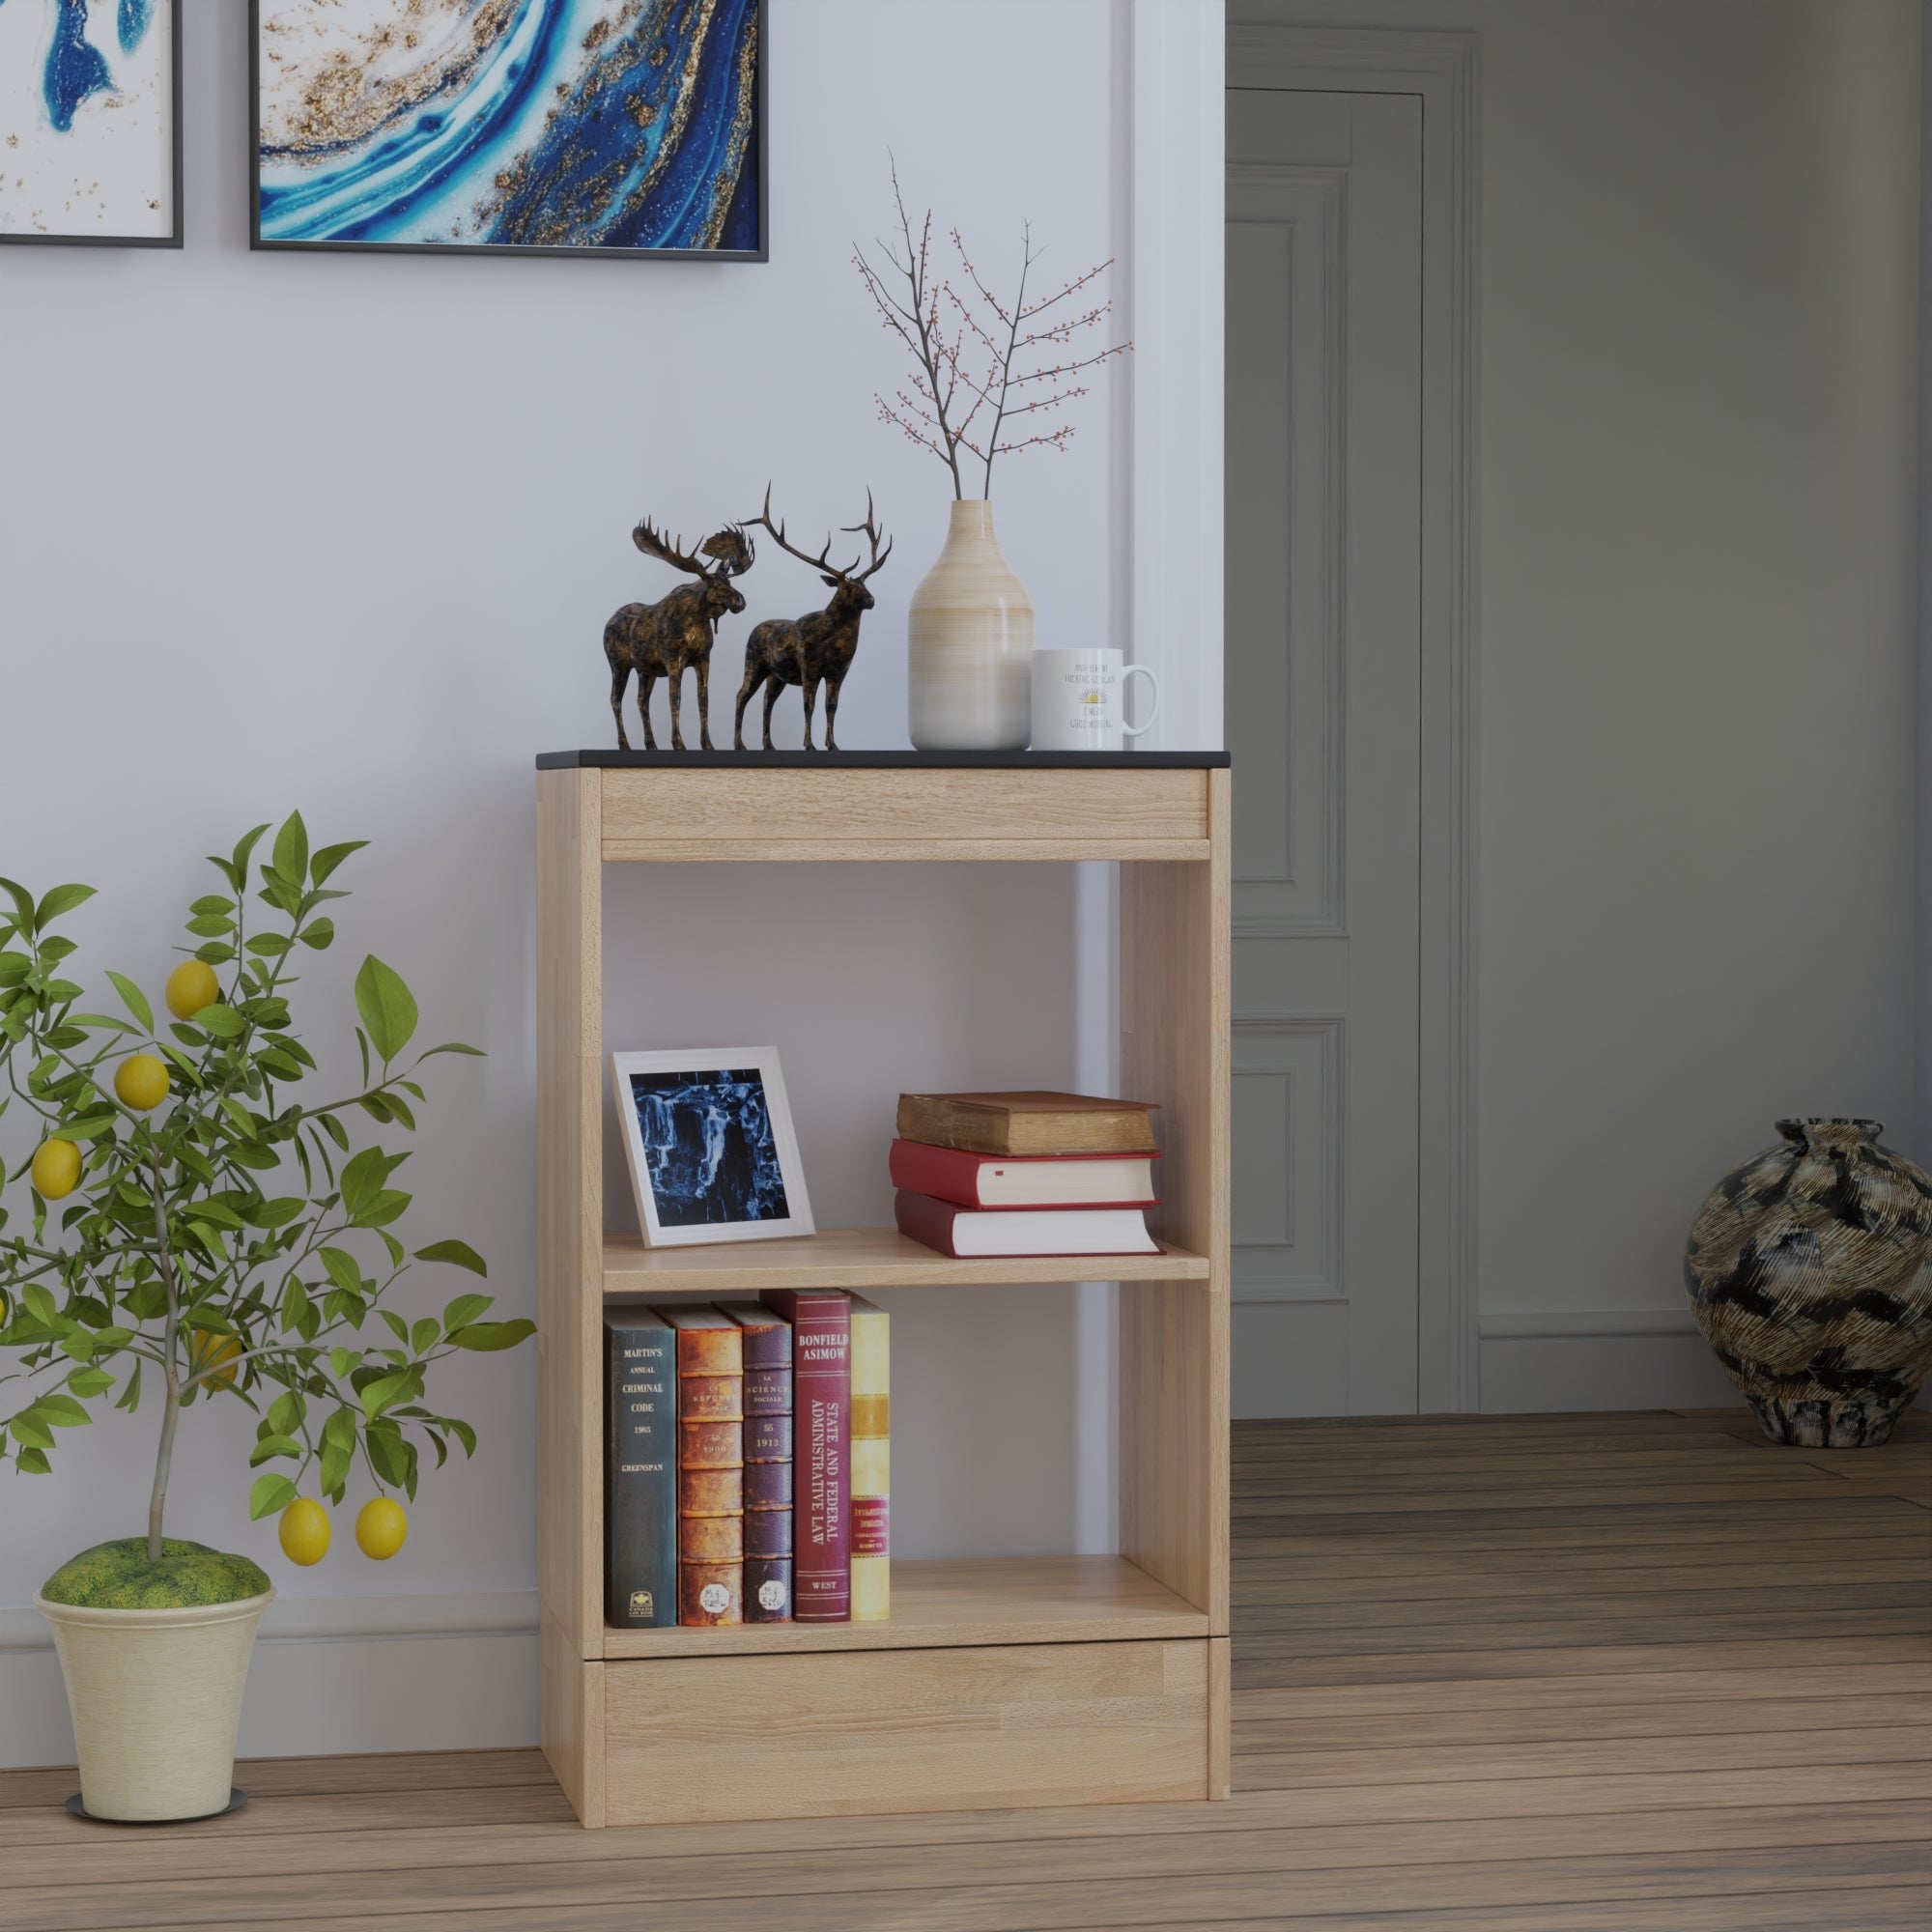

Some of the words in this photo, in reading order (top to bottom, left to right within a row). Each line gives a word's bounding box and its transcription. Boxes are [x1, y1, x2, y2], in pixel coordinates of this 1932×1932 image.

[799, 1334, 849, 1346] BONFIELD
[624, 1348, 663, 1358] MARTIN'S
[804, 1348, 845, 1360] ASIMOW
[622, 1383, 664, 1393] CRIMINAL
[631, 1404, 654, 1412] CODE
[827, 1403, 838, 1443] STATE
[811, 1399, 824, 1511] ADMINISTRATIVE
[621, 1463, 663, 1472] GREENSPAN
[827, 1448, 838, 1476] AND
[827, 1481, 838, 1542] FEDERAL
[811, 1516, 824, 1546] LAW
